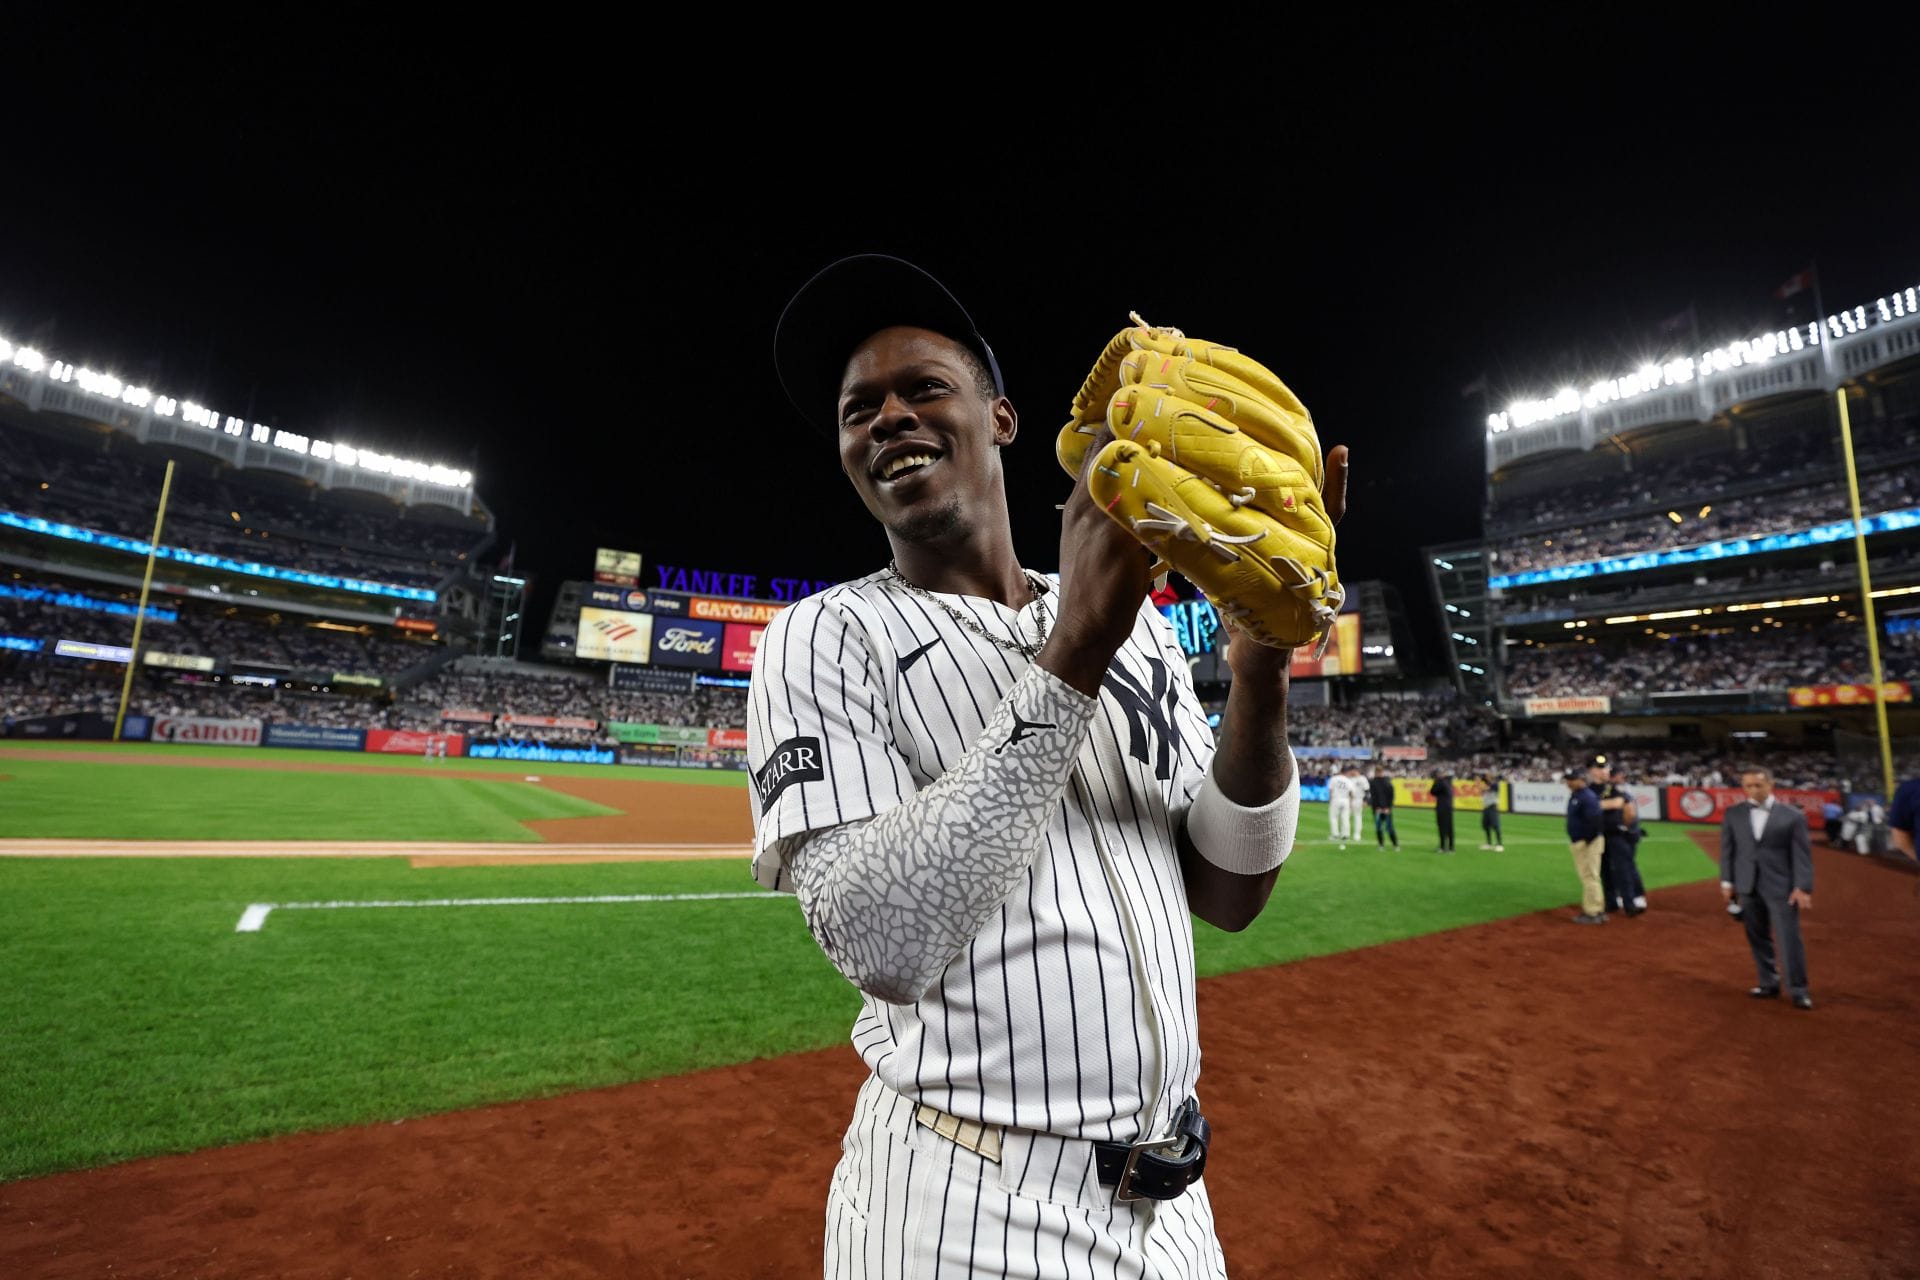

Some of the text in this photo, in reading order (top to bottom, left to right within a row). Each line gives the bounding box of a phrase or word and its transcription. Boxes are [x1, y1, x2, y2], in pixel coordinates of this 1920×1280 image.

[656, 565, 757, 598] YANKEE
[770, 577, 836, 601] STA
[658, 627, 716, 655] Ford
[156, 718, 257, 743] Canon
[760, 746, 820, 805] STARR
